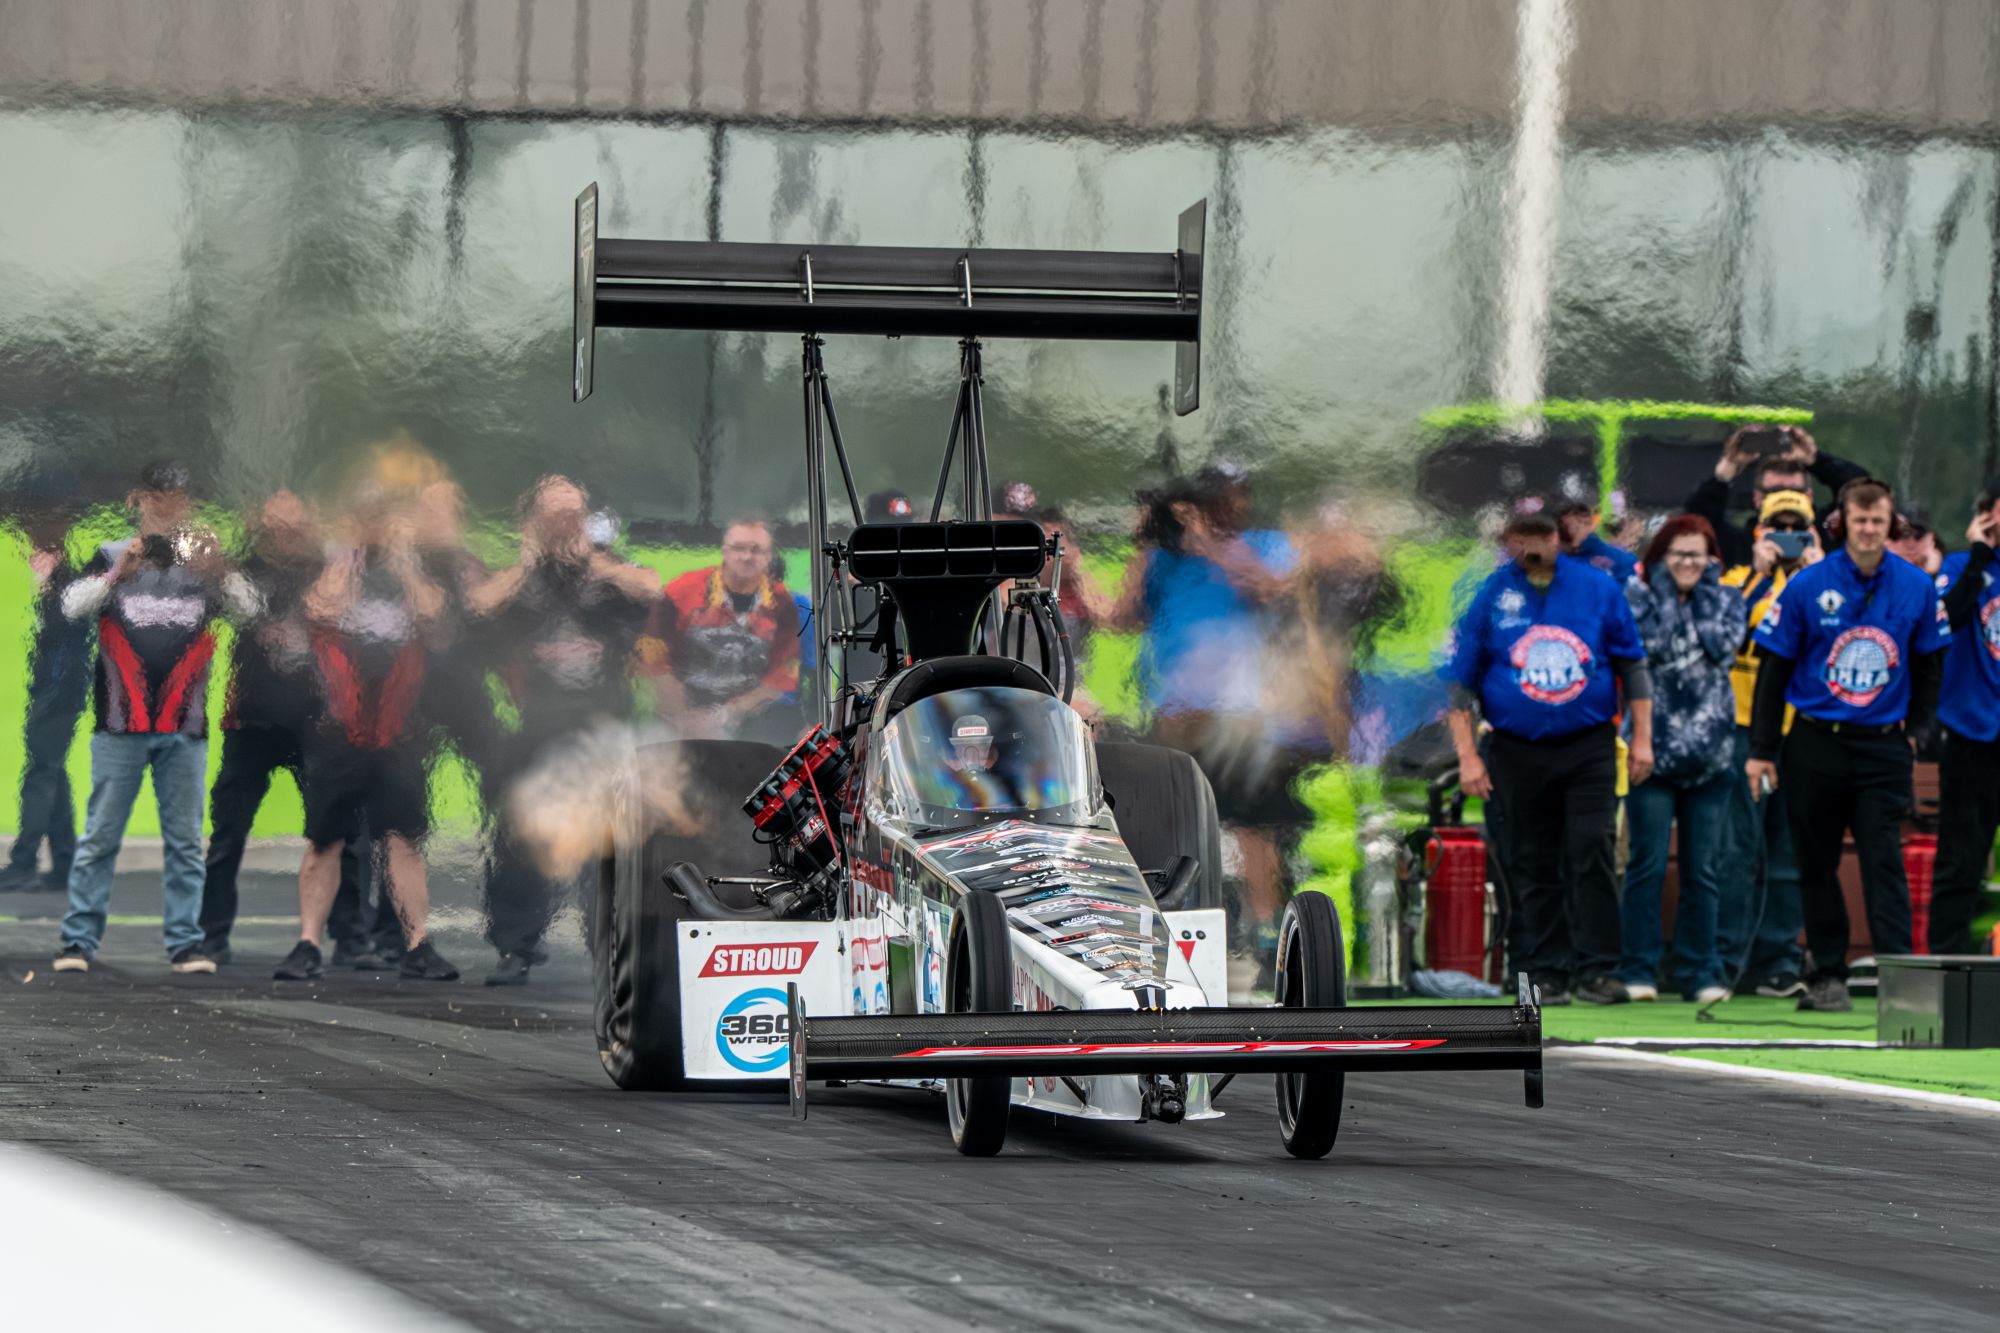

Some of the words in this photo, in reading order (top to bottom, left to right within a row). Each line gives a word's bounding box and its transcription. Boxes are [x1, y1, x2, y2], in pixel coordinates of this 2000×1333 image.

[1828, 667, 1889, 688] IHRA
[713, 947, 803, 973] STROUD
[721, 1015, 790, 1036] 360
[729, 1034, 790, 1045] wraps
